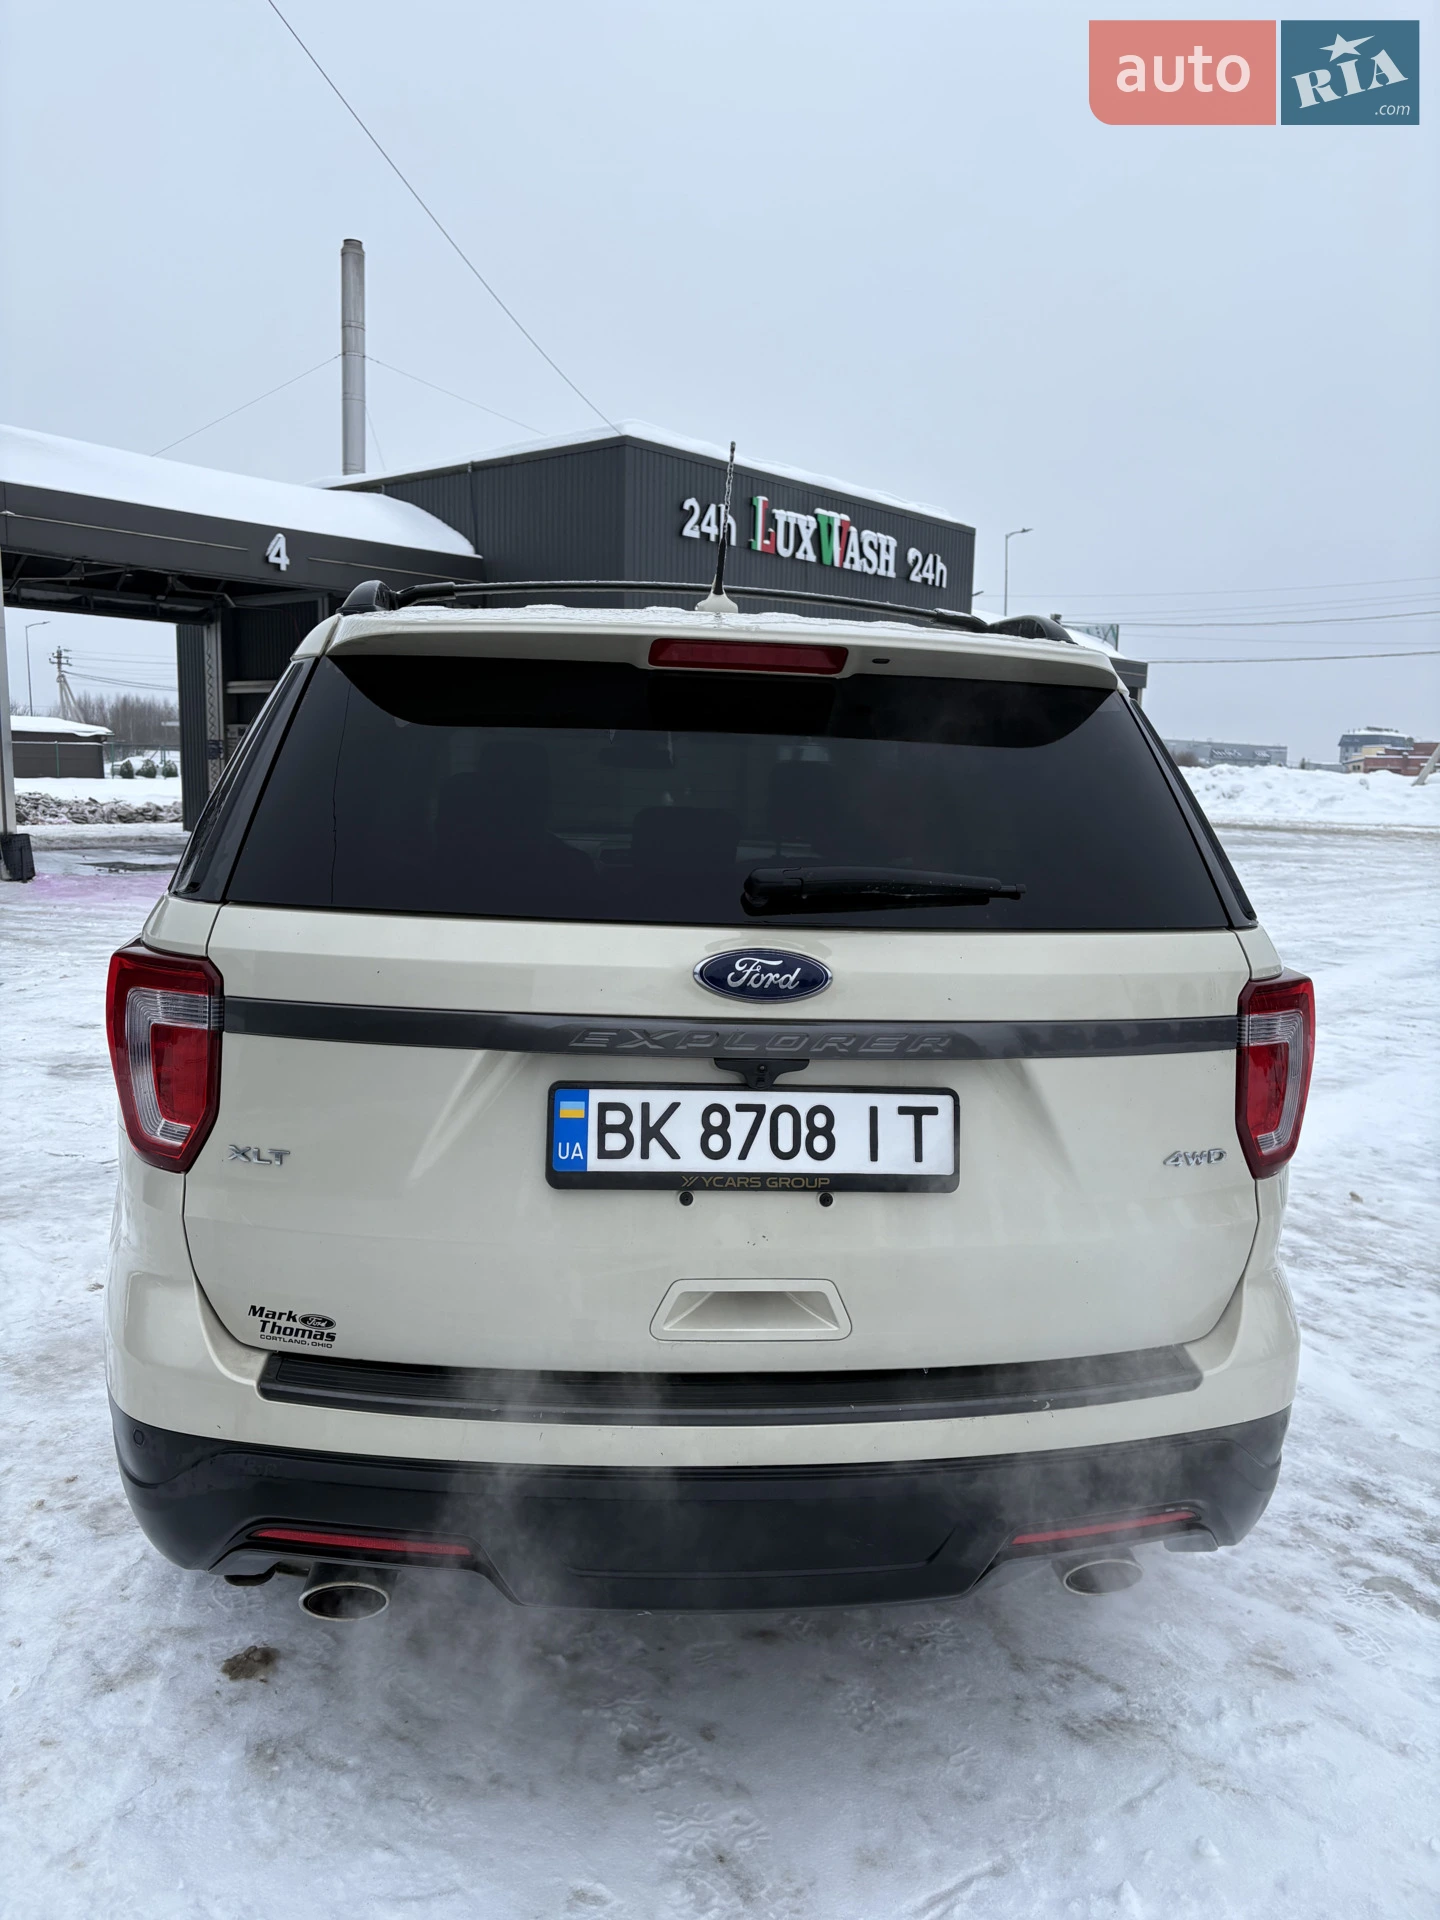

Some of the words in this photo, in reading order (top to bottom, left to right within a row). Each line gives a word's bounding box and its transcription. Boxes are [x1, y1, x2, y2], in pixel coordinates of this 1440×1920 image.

[265, 533, 290, 571] 4
[682, 497, 737, 547] 24h
[907, 547, 947, 588] 24h
[726, 957, 801, 990] Ford
[568, 1027, 952, 1054] EXPLORER
[597, 1101, 682, 1160] BK
[700, 1103, 836, 1162] 8708
[228, 1144, 290, 1166] XLT
[557, 1142, 584, 1160] UA
[1163, 1148, 1227, 1167] 4WD
[701, 1175, 762, 1188] YCARS
[766, 1176, 830, 1189] GROUP
[248, 1304, 298, 1323] Mark
[260, 1319, 337, 1342] Thomas
[311, 1341, 333, 1349] OHIO
